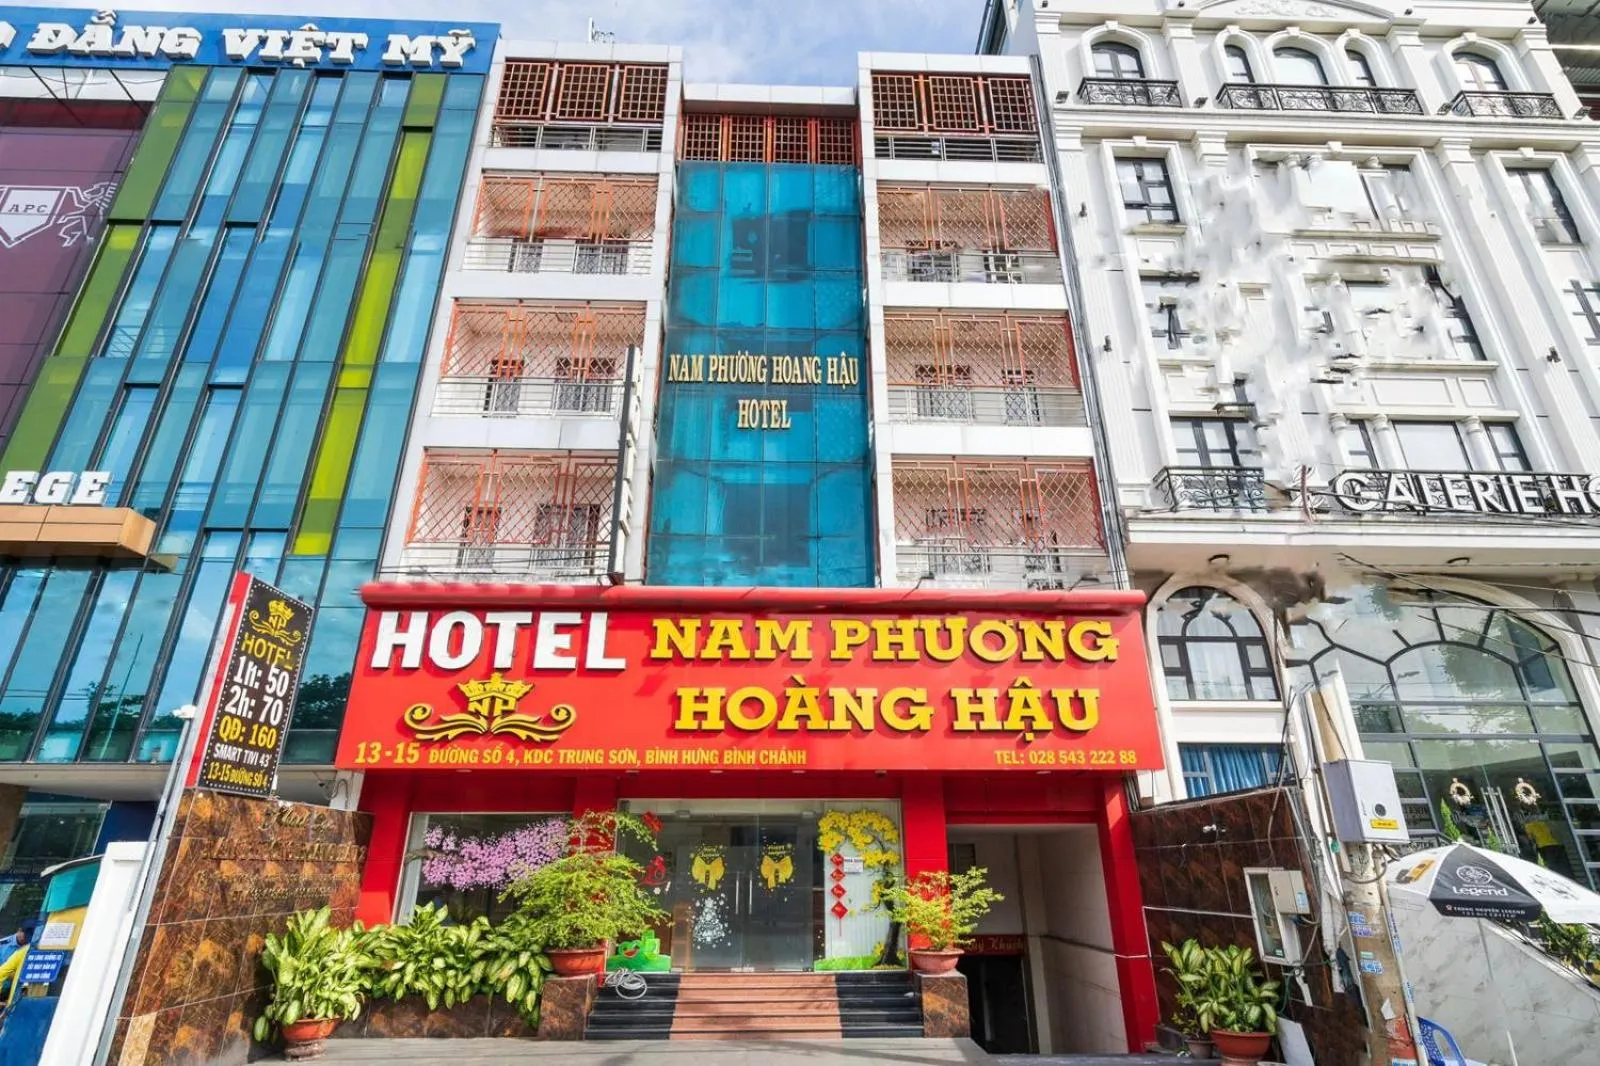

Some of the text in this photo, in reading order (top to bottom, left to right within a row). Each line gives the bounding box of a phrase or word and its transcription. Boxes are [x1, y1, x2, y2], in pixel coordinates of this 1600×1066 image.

[222, 23, 368, 67] VIỆT
[382, 29, 476, 67] MỸ
[7, 203, 49, 214] APC
[668, 354, 704, 382] NAM
[771, 355, 822, 384] HOANG
[826, 351, 859, 389] HẬU
[737, 398, 792, 430] HOTEL
[1335, 471, 1546, 514] GALERIE
[241, 632, 294, 672] HOTEL
[371, 611, 627, 670] HOTEL
[650, 618, 813, 661] NAM
[233, 655, 290, 698] 1h: 50
[224, 685, 284, 727] 2h: 70
[674, 674, 1101, 742] HOÀNG HẬU
[213, 743, 243, 763] SMART
[242, 749, 260, 767] TIVI
[248, 723, 277, 750] 160
[428, 745, 479, 764] ĐƯỜNG
[482, 742, 504, 764] SỐ
[506, 749, 520, 766] 4,
[523, 749, 554, 764] KDC
[558, 749, 604, 764] TRUNG
[608, 748, 641, 767] SƠN,
[645, 746, 678, 765] BÌNH
[723, 746, 756, 765] BÌNH
[759, 746, 807, 765] CHÁNH
[994, 749, 1138, 765] TEL: 028 543 222 88
[1452, 885, 1510, 897] Legend
